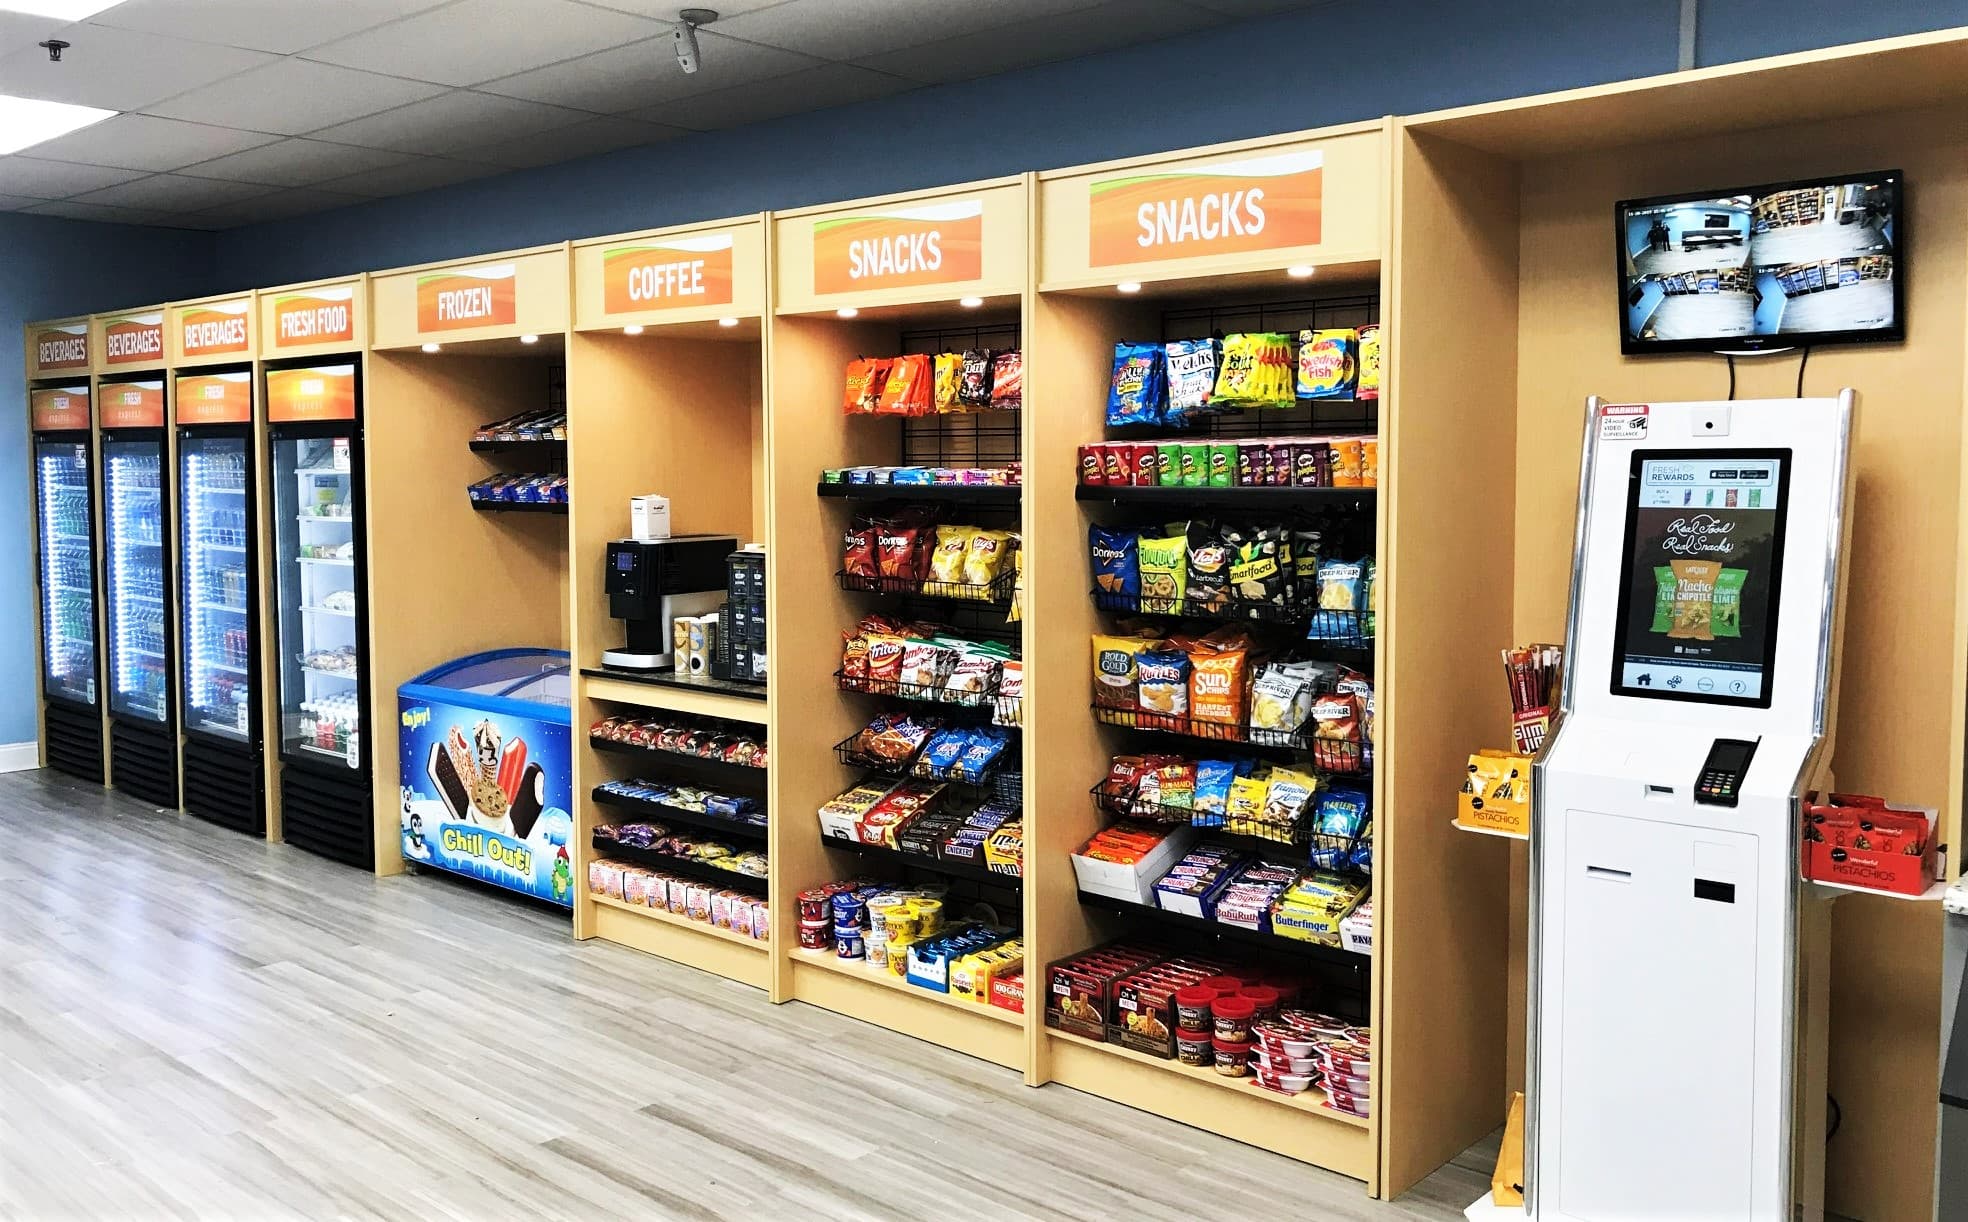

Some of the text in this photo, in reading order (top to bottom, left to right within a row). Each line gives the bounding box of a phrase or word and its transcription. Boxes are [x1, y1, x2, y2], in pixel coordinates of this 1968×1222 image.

[1137, 187, 1265, 248] SNACKS
[849, 231, 942, 279] SNACKS
[628, 259, 705, 301] COFFEE
[438, 286, 492, 321] FROZEN
[281, 305, 347, 338] FRESH FOOD
[185, 318, 245, 348] BEVERAGES
[108, 329, 161, 356] BEVERAGES
[39, 339, 86, 363] BEVERAGES
[1170, 353, 1212, 370] Welch's
[1300, 357, 1343, 372] Swedish
[1309, 366, 1332, 379] Fish
[205, 385, 225, 400] FRESH
[300, 379, 324, 395] FRESH
[54, 397, 70, 410] FRESH
[124, 391, 142, 406] FRESH
[1606, 407, 1645, 415] WARNING
[1651, 473, 1695, 481] REWARDS
[1667, 514, 1735, 537] Real Food
[1093, 546, 1125, 558] Doritos
[1662, 535, 1735, 555] Real Snacks
[1319, 567, 1360, 578] DEEP RIVER
[1677, 578, 1713, 592] Nacho
[1676, 591, 1713, 602] CHIPOTLE
[1104, 651, 1128, 662] ROLD
[1101, 660, 1128, 673] GOLD
[1140, 665, 1180, 681] RUFFLES
[1001, 677, 1022, 689] Com
[1195, 672, 1232, 695] Sun
[1270, 682, 1291, 697] RIVER
[1206, 686, 1230, 695] CHIPS
[1328, 707, 1349, 715] RIVER
[1518, 709, 1544, 720] ORIGINAL
[401, 707, 431, 732] Enjoy!
[1273, 783, 1310, 795] Famous
[1473, 811, 1520, 825] PISTACHIOS
[443, 829, 532, 876] Chill Out!
[946, 845, 973, 857] SNICKERS
[1184, 855, 1221, 866] CRUNCH
[1850, 857, 1879, 866] Wonderful
[1172, 866, 1208, 877] CRUNCH
[1832, 864, 1896, 882] PISTACHIOS
[1160, 877, 1196, 888] CRUNCH
[1275, 914, 1329, 932] Butterfinger
[1352, 934, 1372, 945] PAY
[1055, 985, 1070, 995] MEIN
[1121, 998, 1136, 1010] MEIN
